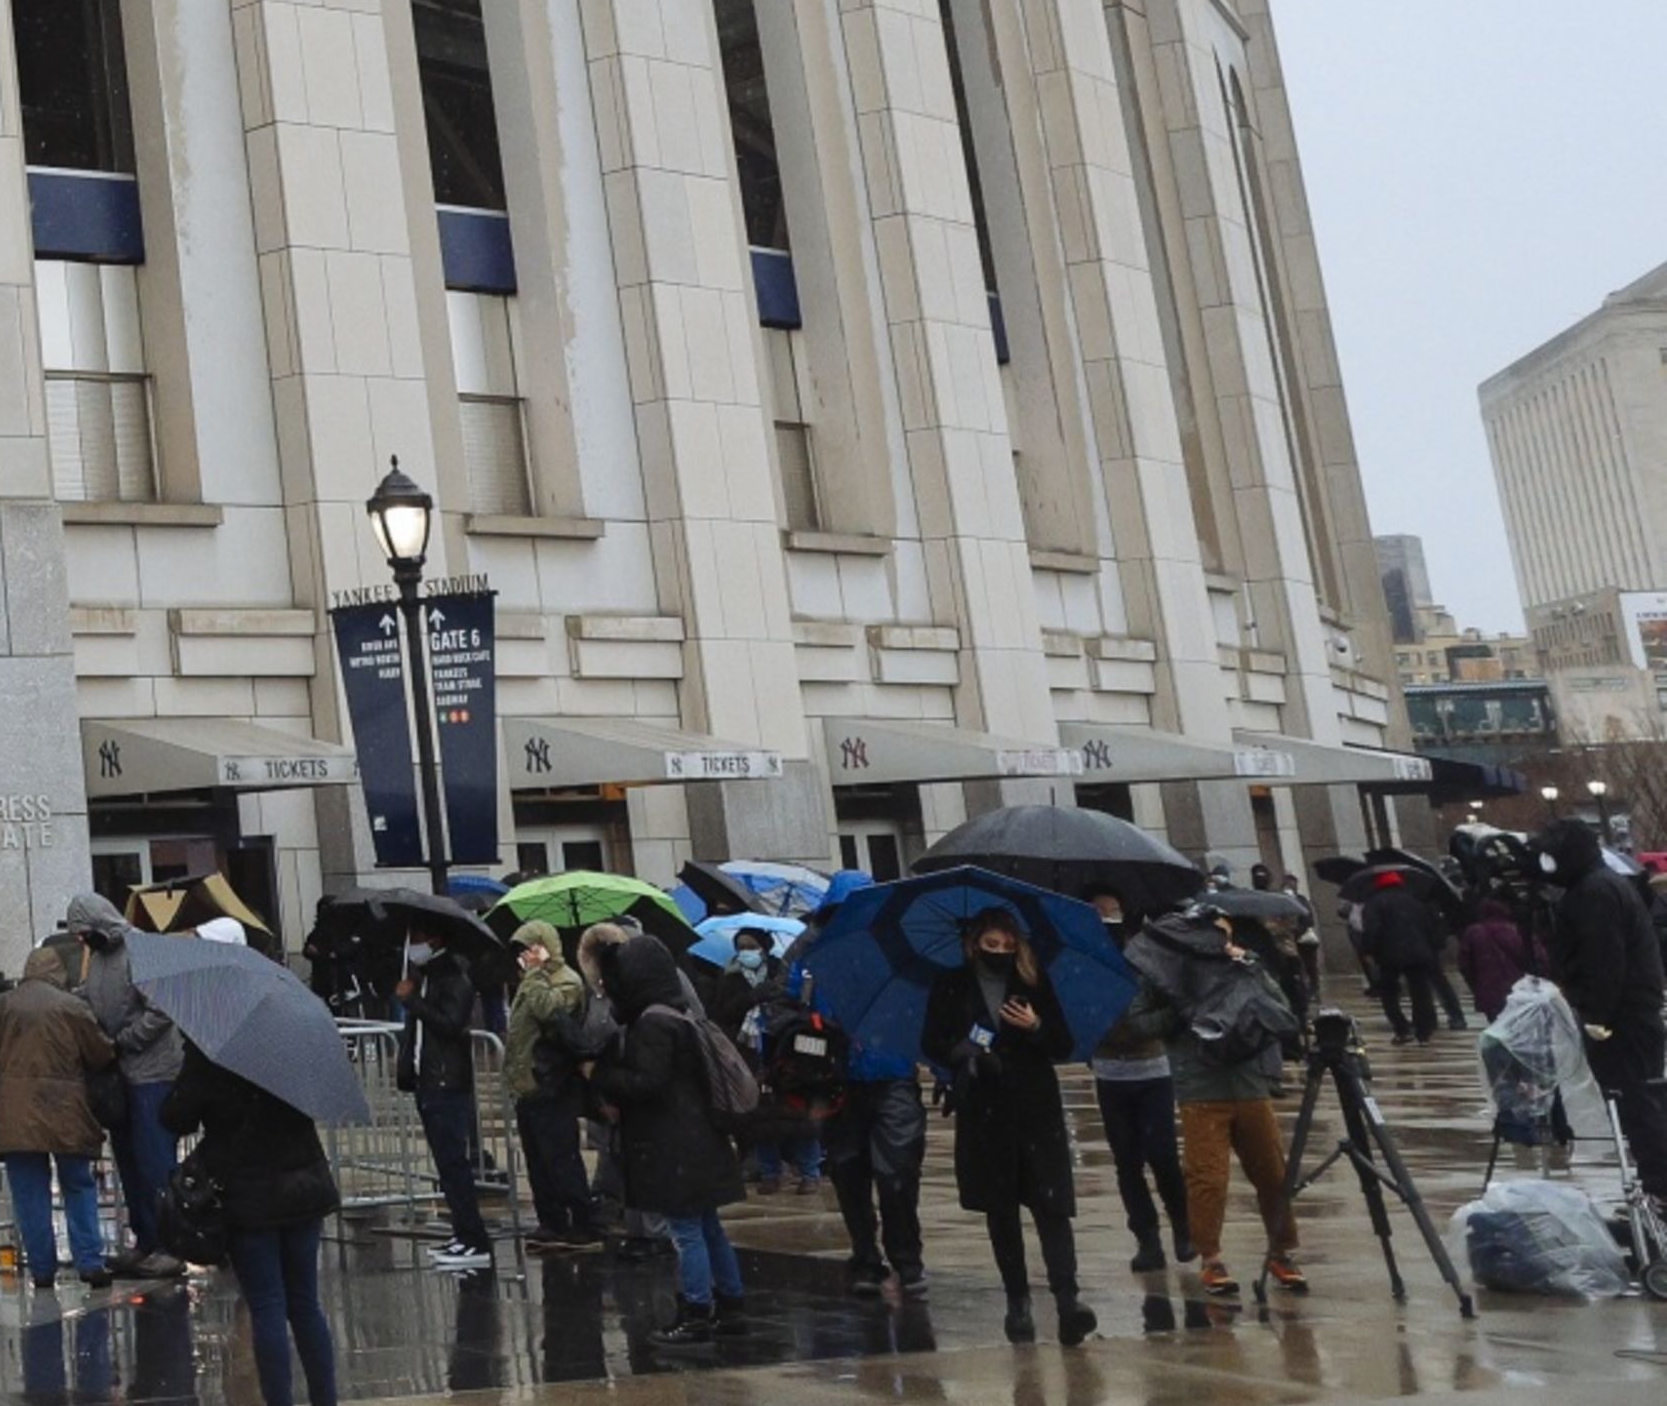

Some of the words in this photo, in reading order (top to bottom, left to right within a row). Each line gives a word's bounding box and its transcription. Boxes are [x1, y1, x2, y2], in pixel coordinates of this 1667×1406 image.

[332, 585, 392, 607] YANKEE
[425, 573, 489, 595] STADIUM
[431, 631, 467, 651] GATE
[471, 629, 480, 647] 6
[265, 760, 328, 778] TICKETS
[701, 756, 750, 773] TICKETS
